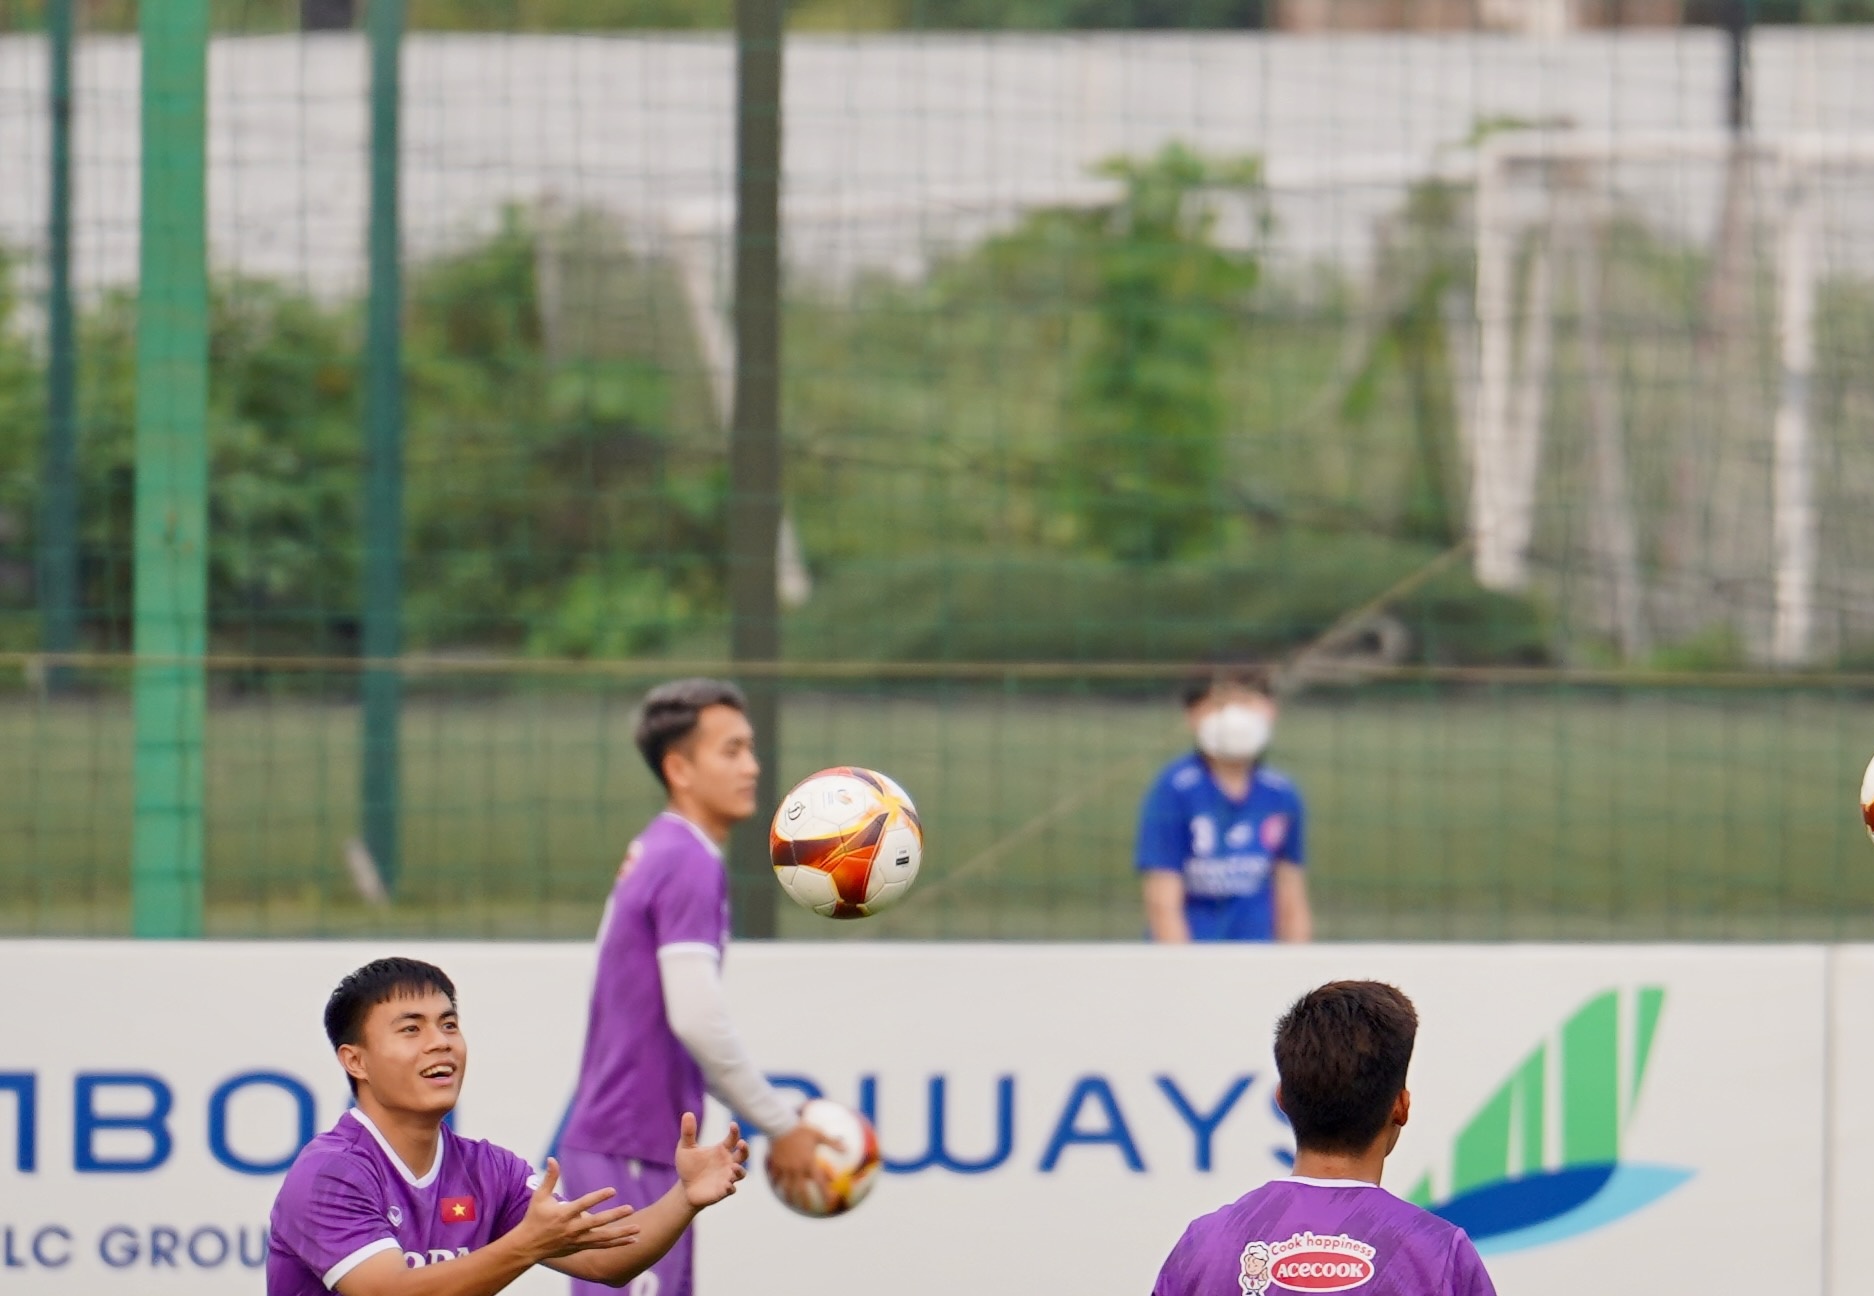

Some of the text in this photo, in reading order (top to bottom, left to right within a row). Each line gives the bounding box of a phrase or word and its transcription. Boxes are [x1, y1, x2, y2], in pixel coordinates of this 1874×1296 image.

[98, 1224, 269, 1269] GROU
[1271, 1235, 1373, 1258] Cook happiness
